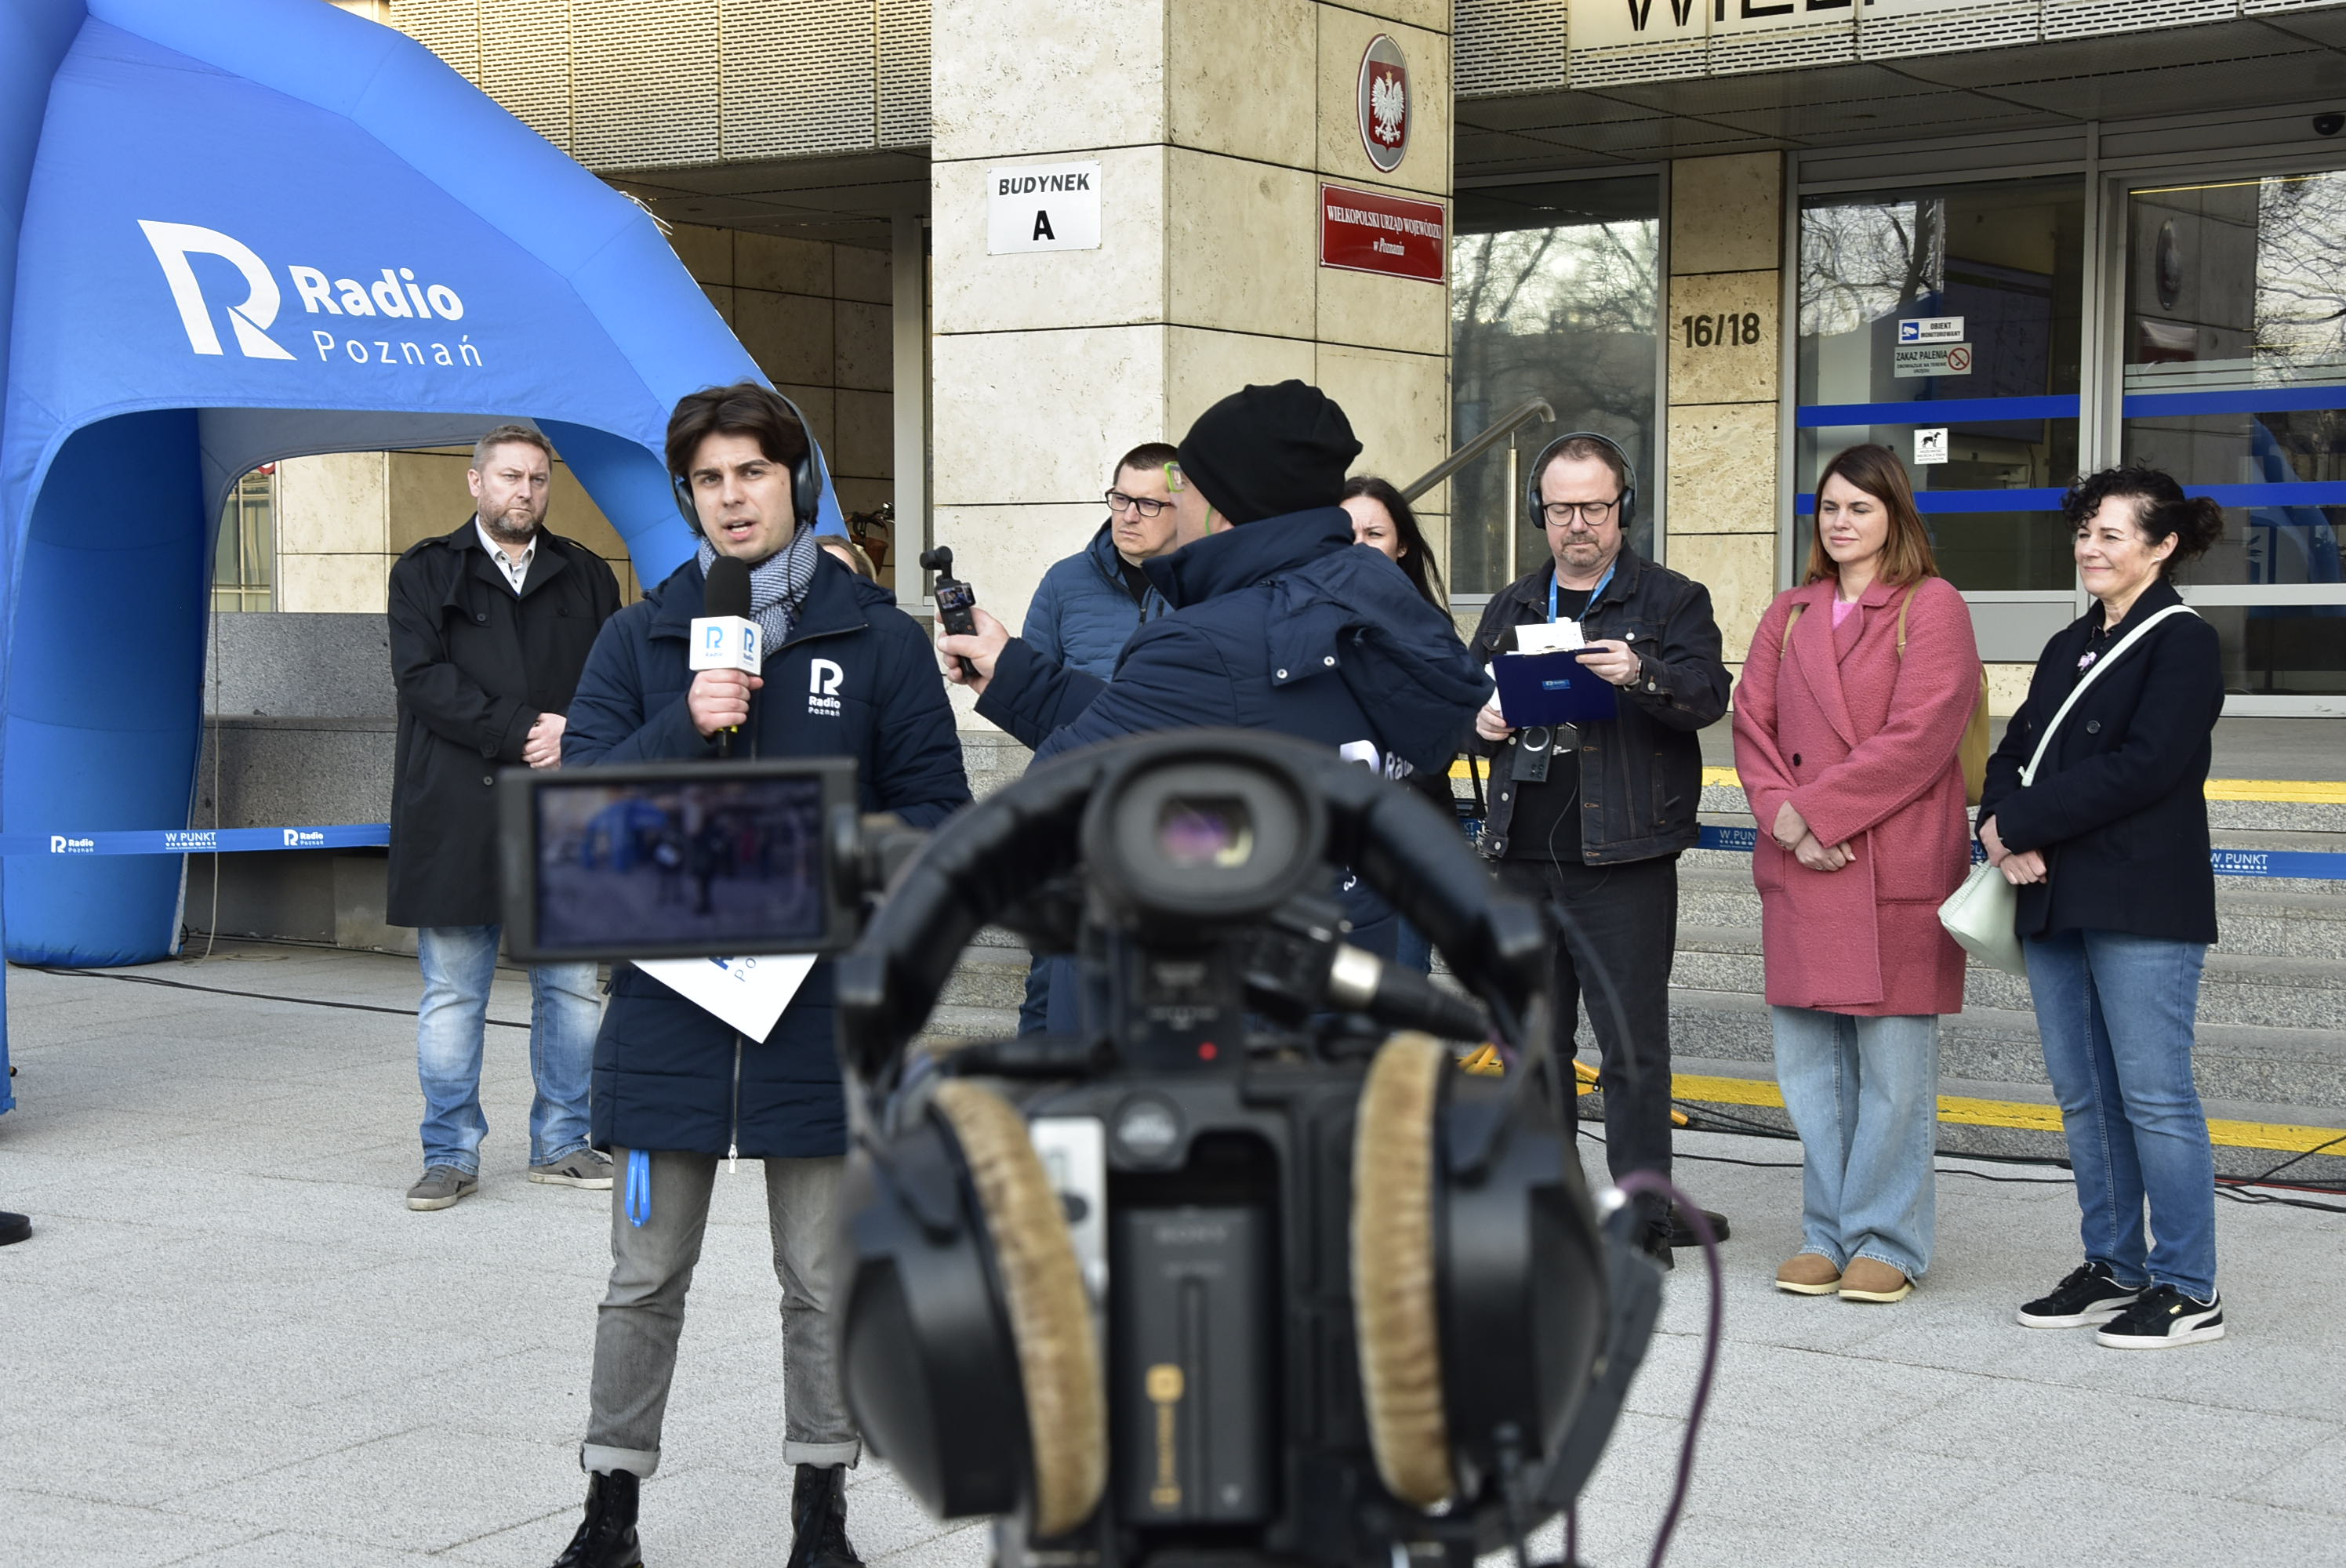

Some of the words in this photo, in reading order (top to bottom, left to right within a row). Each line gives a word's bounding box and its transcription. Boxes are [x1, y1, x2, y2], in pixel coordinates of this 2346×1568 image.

[999, 173, 1090, 195] BUDYNEK
[1033, 210, 1055, 241] A
[1327, 205, 1380, 228] WIELKOPOLSKI
[1380, 214, 1403, 234] URZĄD
[1403, 217, 1442, 240] WOJEWÓDZKI
[1373, 241, 1379, 252] w
[1378, 238, 1405, 256] Poznaniu
[288, 265, 464, 321] Radio
[1682, 312, 1760, 348] 16/18
[313, 330, 483, 367] Poznań
[1896, 351, 1918, 361] ZAKAZ
[1919, 350, 1948, 360] PALENIA
[808, 696, 841, 709] Radio
[165, 833, 177, 842] W
[180, 832, 216, 841] PUNKT
[300, 831, 324, 840] Radio
[1720, 829, 1730, 840] W
[68, 838, 94, 847] Radio
[2225, 853, 2268, 865] PUNKT
